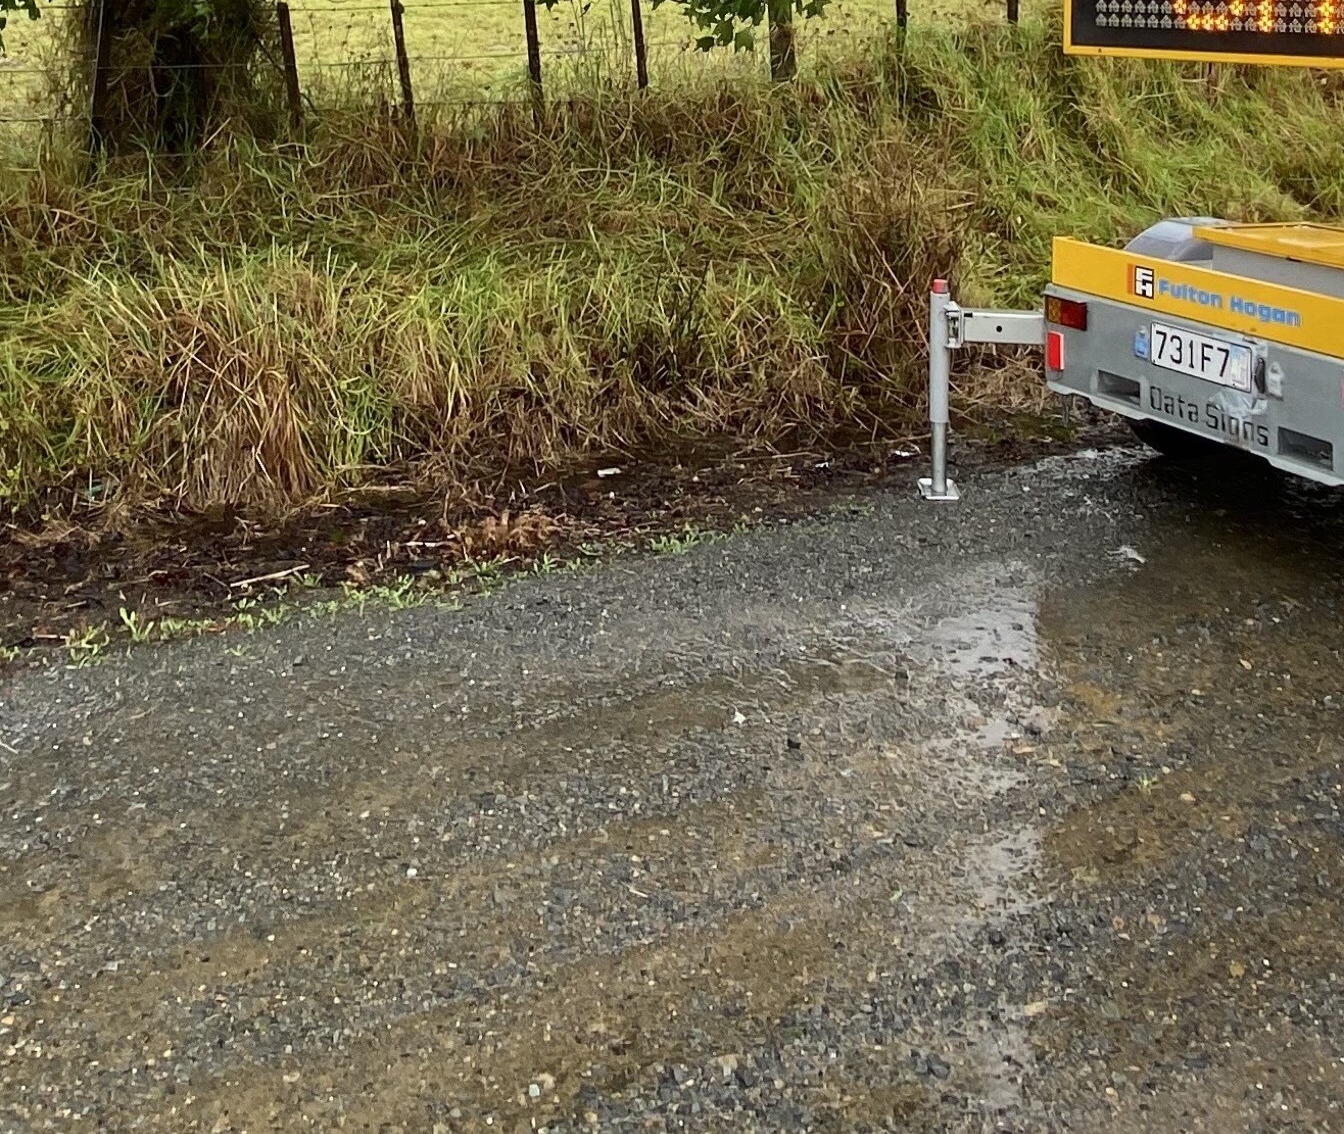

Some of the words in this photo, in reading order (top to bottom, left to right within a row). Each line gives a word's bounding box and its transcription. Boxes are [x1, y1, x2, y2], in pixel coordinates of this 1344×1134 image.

[1158, 279, 1223, 308] Fulton
[1230, 295, 1302, 327] Hogan
[1155, 329, 1230, 378] 731F7
[1150, 385, 1199, 423] Data
